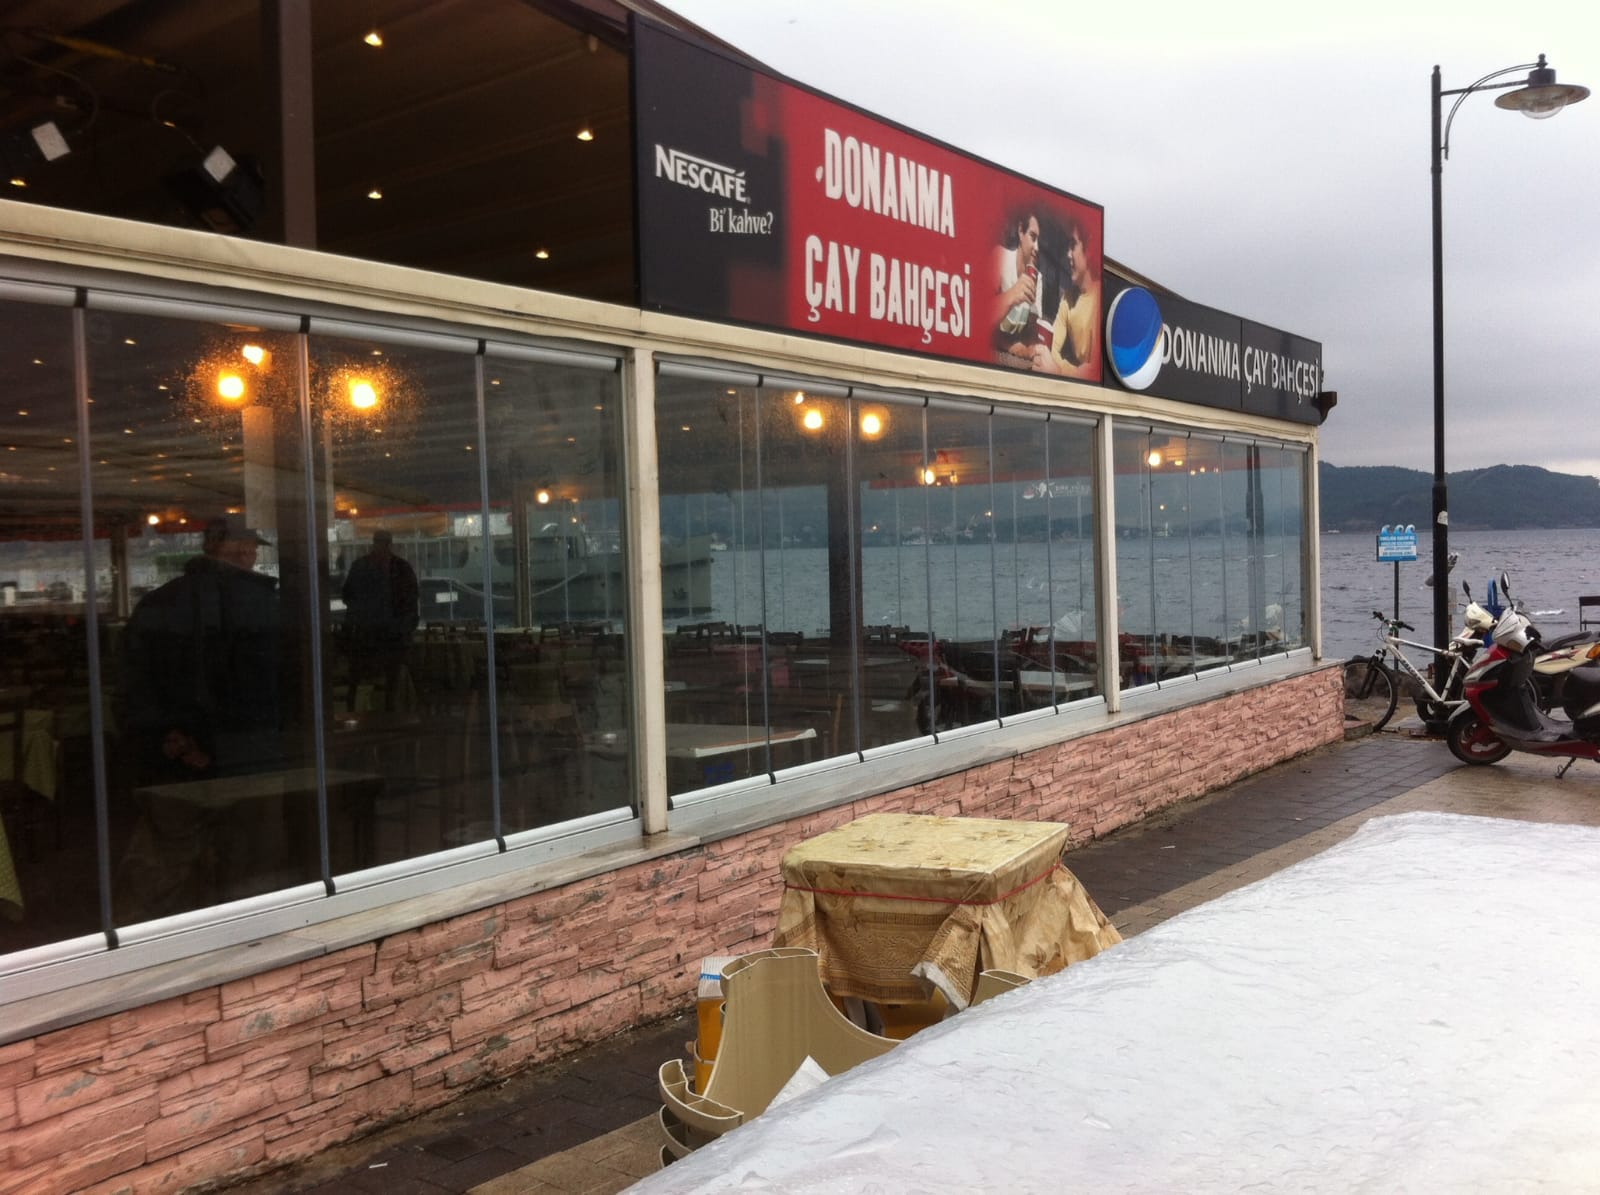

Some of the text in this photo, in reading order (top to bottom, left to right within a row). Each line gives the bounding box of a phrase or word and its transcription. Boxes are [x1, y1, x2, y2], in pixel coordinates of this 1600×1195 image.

[655, 144, 747, 202] NESCAFÉ
[824, 128, 956, 238] DONANMA
[728, 208, 774, 234] kahve?
[805, 234, 971, 344] ÇAY BAHÇESİ
[1161, 323, 1319, 404] DONANMA ÇAY BAHÇESİ
